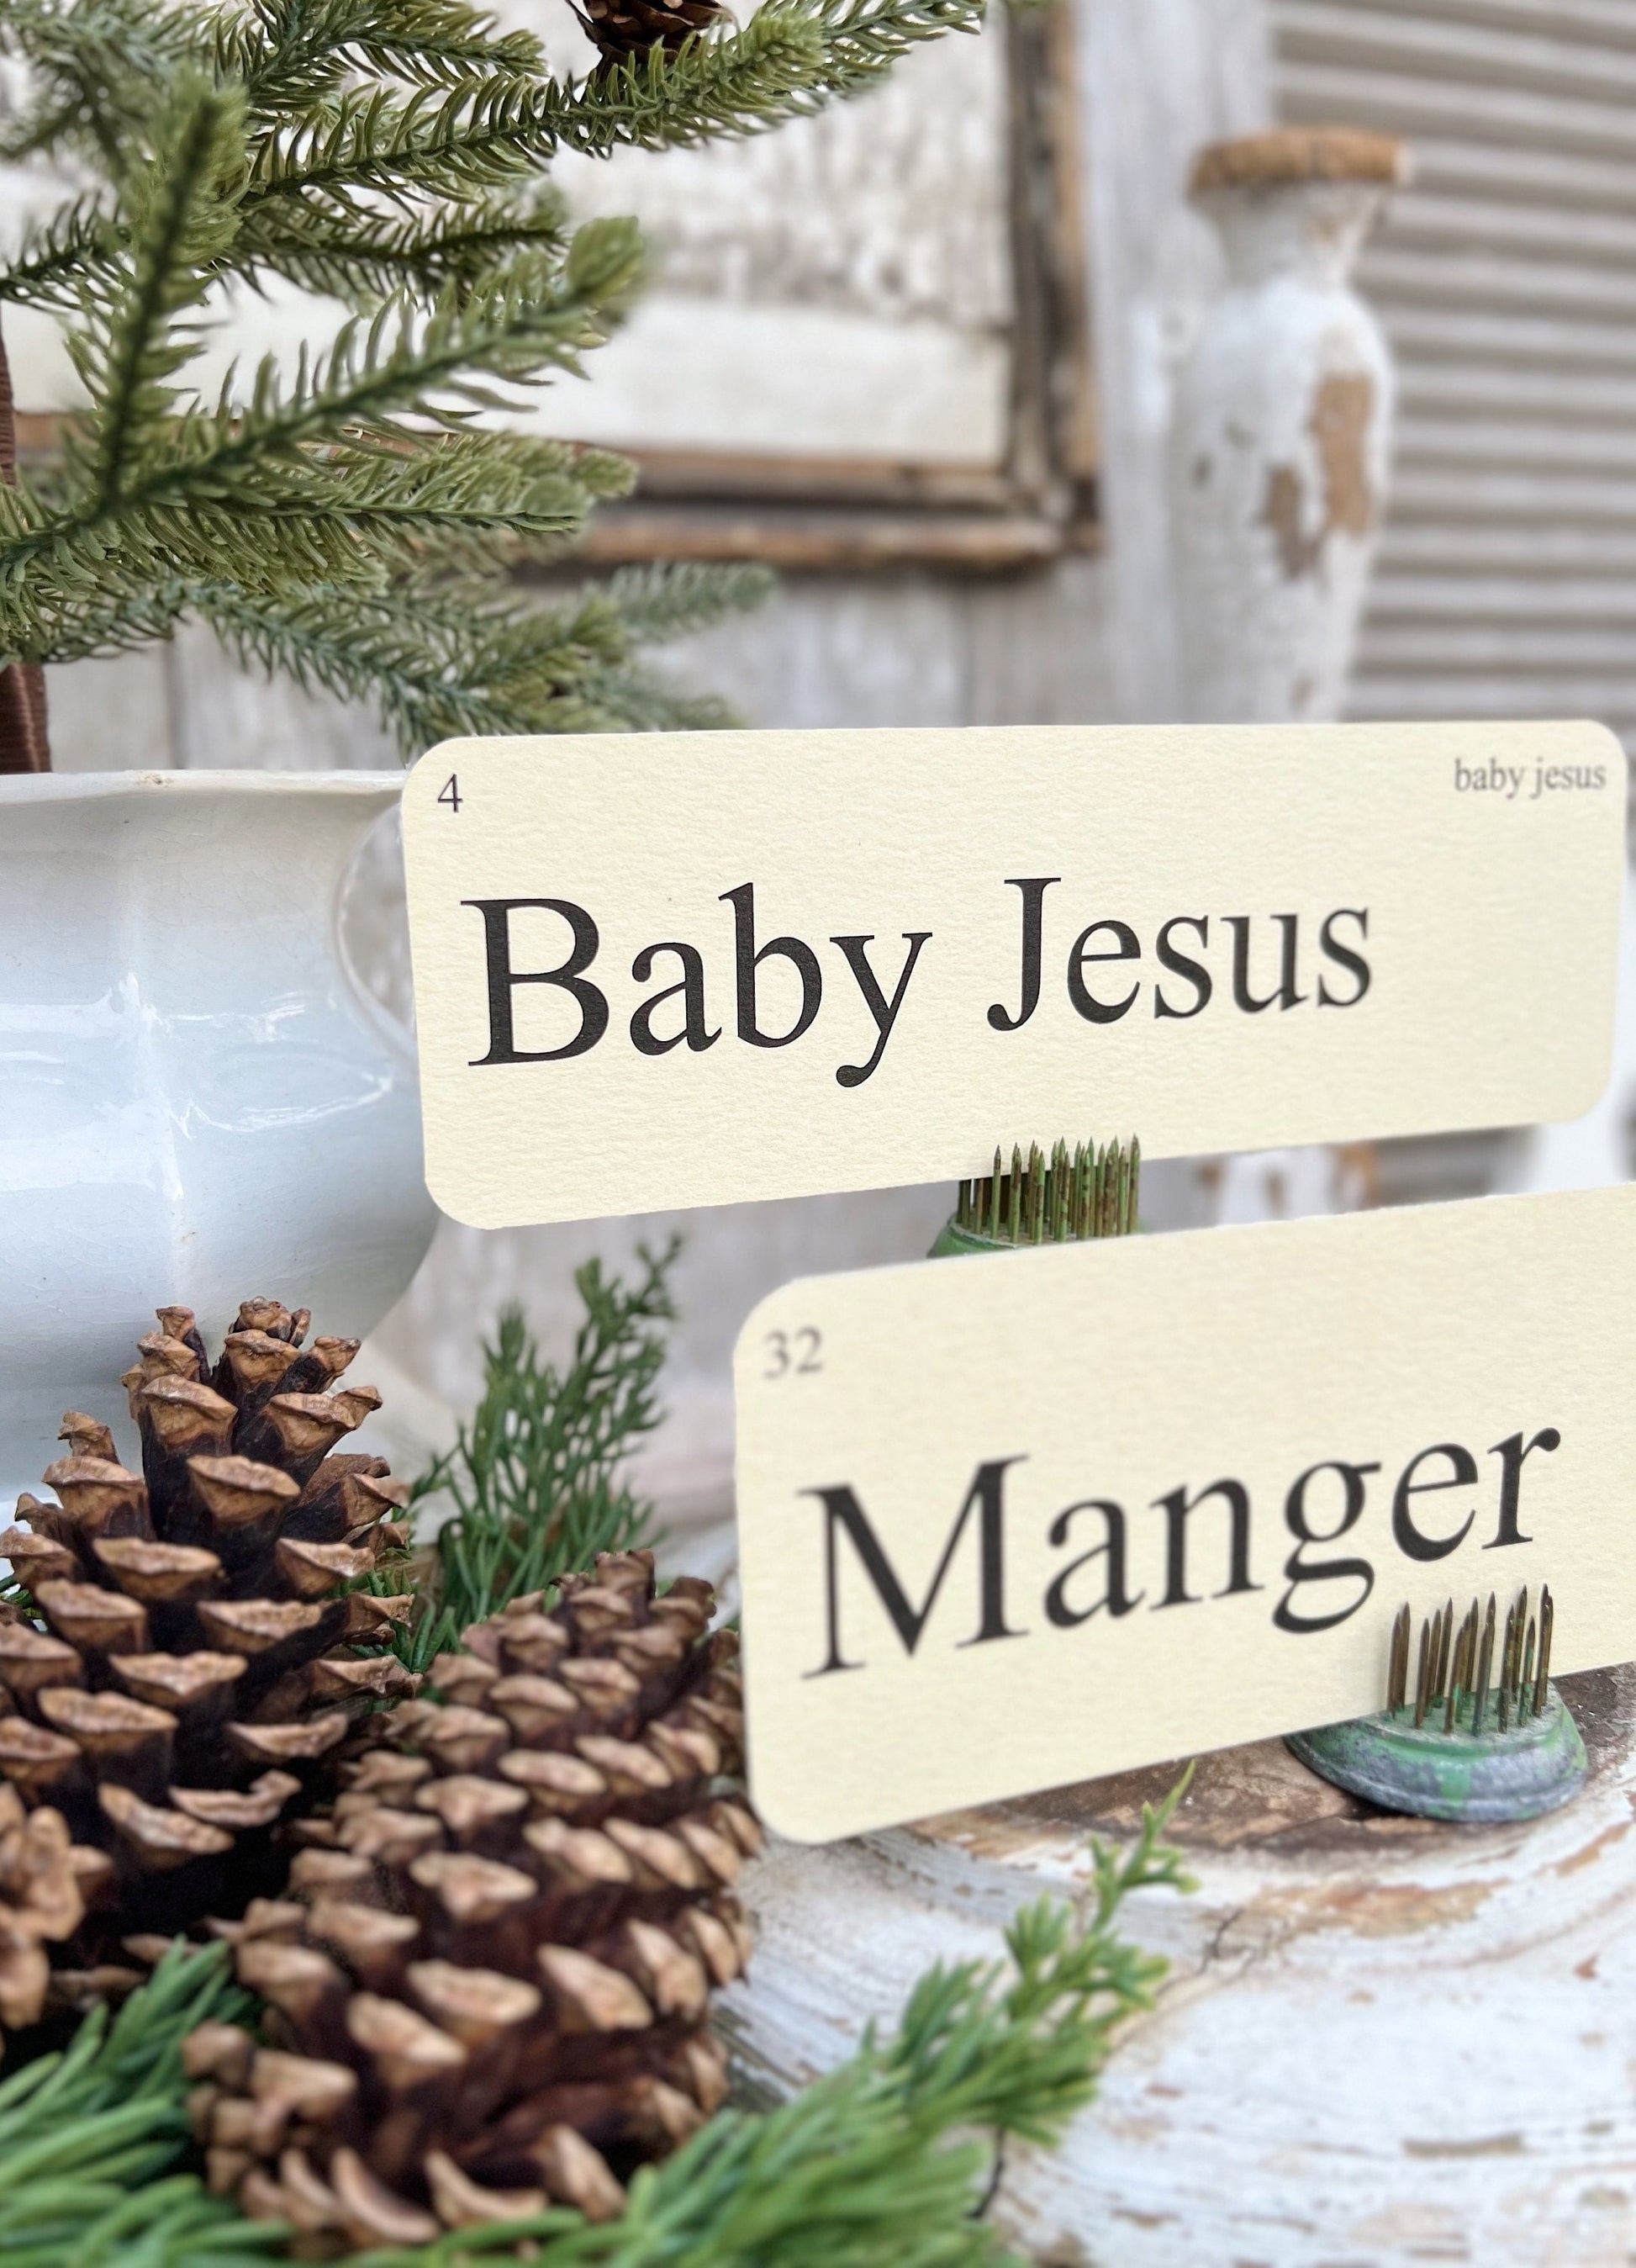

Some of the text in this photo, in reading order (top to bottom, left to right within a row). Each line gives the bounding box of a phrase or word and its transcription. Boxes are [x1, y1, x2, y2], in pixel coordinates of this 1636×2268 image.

[435, 772, 464, 814] 4
[1454, 757, 1607, 800] baby jesus
[459, 876, 1372, 1089] Baby Jesus
[762, 1325, 824, 1380] 32
[802, 1427, 1562, 1680] Manger
